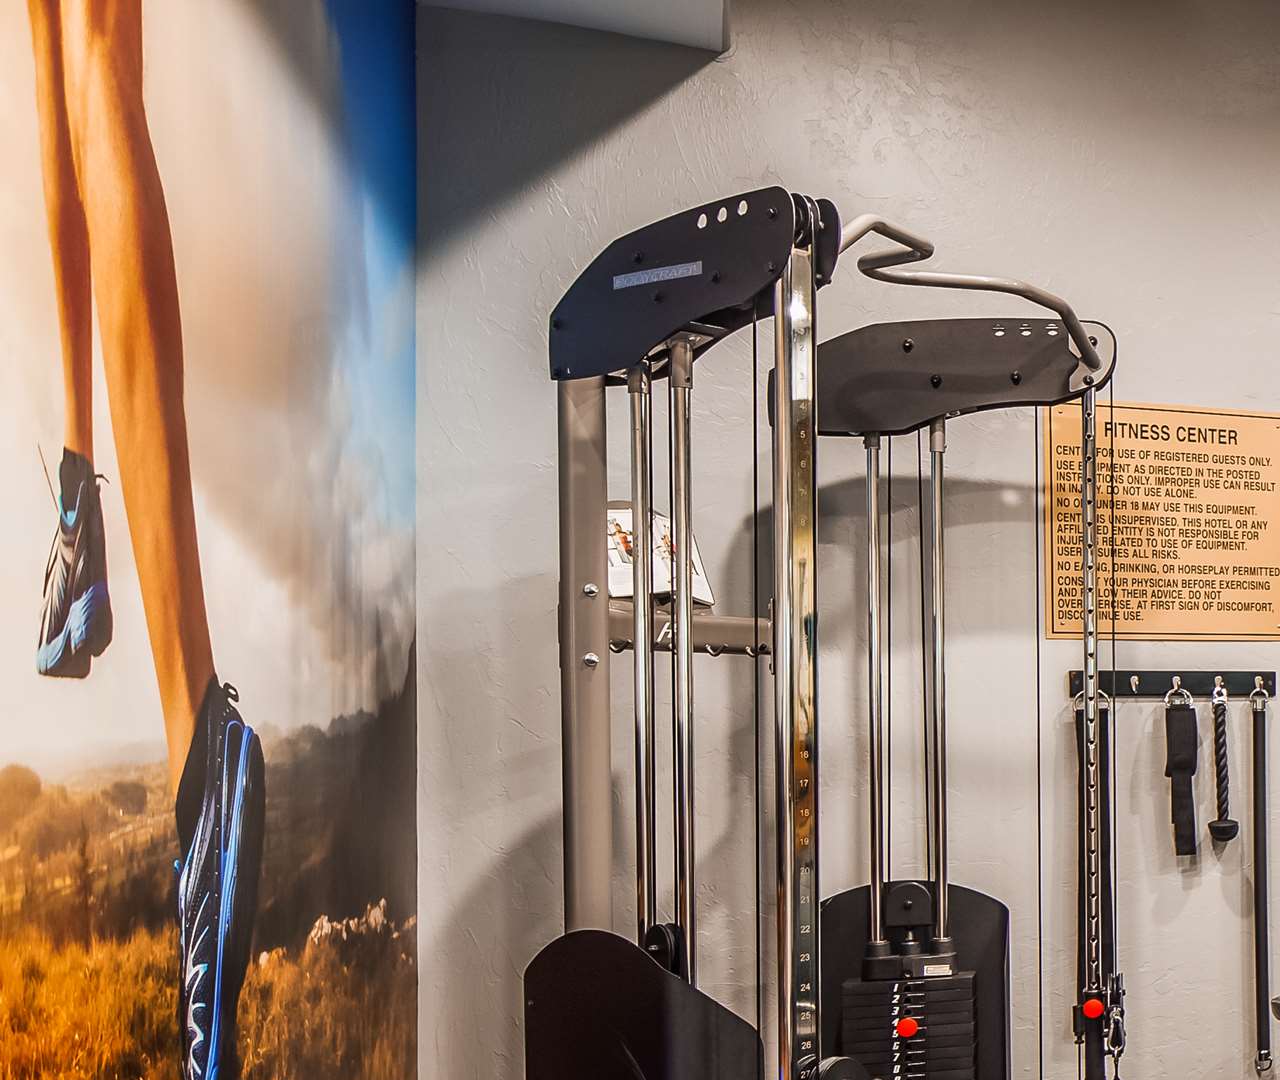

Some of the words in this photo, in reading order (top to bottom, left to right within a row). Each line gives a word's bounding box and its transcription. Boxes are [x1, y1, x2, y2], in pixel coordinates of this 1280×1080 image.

[1104, 421, 1170, 441] FITNESS
[1176, 425, 1238, 445] CENTER
[1056, 445, 1084, 456] CENT
[1096, 448, 1114, 458] FOR
[1118, 449, 1135, 459] USE
[1139, 450, 1151, 459] OF
[1154, 451, 1209, 463] REGISTERED
[1212, 455, 1247, 465] GUESTS
[1249, 457, 1272, 466] ONLY.
[1056, 461, 1075, 471] USE
[1078, 461, 1130, 473] EIPMENT
[1134, 465, 1145, 474] AS
[1149, 465, 1192, 477] DIRECTED
[1195, 468, 1204, 477] IN
[1207, 469, 1223, 478] THE
[1226, 470, 1260, 480] POSTED
[1056, 472, 1124, 484] INSTRTIONS
[1127, 475, 1152, 485] ONLY.
[1155, 477, 1200, 488] IMPROPER
[1203, 479, 1220, 489] USE
[1223, 480, 1240, 490] CAN
[1244, 481, 1276, 491] RESULT
[1056, 483, 1066, 492] IN
[1069, 484, 1104, 494] INJY.
[1106, 486, 1119, 494] DO
[1123, 486, 1141, 495] NOT
[1144, 487, 1161, 497] USE
[1165, 488, 1197, 498] ALONE.
[1056, 498, 1070, 507] NO
[1131, 501, 1140, 510] 18
[1142, 502, 1160, 511] MAY
[1163, 502, 1181, 512] USE
[1184, 503, 1203, 513] THIS
[1206, 504, 1257, 516] EQUIPMENT.
[1057, 513, 1084, 522] CENT
[1096, 514, 1105, 523] IS
[1109, 515, 1179, 527] UNSUPERVISED.
[1182, 517, 1201, 527] THIS
[1204, 518, 1233, 529] HOTEL
[1235, 520, 1248, 529] OR
[1250, 521, 1268, 531] ANY
[1057, 524, 1108, 535] AFFILED
[1112, 526, 1143, 536] ENTITY
[1146, 528, 1155, 536] IS
[1157, 528, 1176, 537] NOT
[1179, 529, 1239, 540] RESPONSIBLE
[1242, 531, 1259, 540] FOR
[1102, 537, 1143, 547] RELATED
[1146, 539, 1157, 548] TO
[1161, 539, 1178, 548] USE
[1181, 540, 1193, 549] OF
[1196, 540, 1247, 551] EQUIPMENT.
[1057, 547, 1082, 556] USER
[1094, 548, 1129, 558] SUMES
[1132, 549, 1149, 558] ALL
[1152, 549, 1180, 560] RISKS.
[1057, 561, 1071, 570] NO
[1074, 562, 1110, 573] EANG,
[1113, 563, 1159, 574] DRINKING,
[1162, 564, 1175, 573] OR
[1178, 565, 1230, 575] HORSEPLAY
[1104, 577, 1128, 587] YOUR
[1132, 578, 1178, 588] PHYSICIAN
[1181, 579, 1216, 589] BEFORE
[1219, 580, 1271, 591] EXERCISING
[1058, 588, 1077, 597] AND
[1122, 589, 1147, 598] THEIR
[1151, 590, 1185, 599] ADVICE.
[1188, 590, 1201, 599] DO
[1204, 591, 1222, 600] NOT
[1137, 600, 1148, 609] AT
[1151, 601, 1175, 610] FIRST
[1179, 601, 1199, 610] SIGN
[1202, 601, 1214, 611] OF
[1217, 601, 1274, 613] DISCOMFORT,
[1058, 610, 1120, 620] DISCOINUE
[1123, 611, 1144, 621] USE.
[799, 779, 809, 787] 17
[800, 925, 811, 934] 22
[800, 953, 811, 962] 23
[800, 983, 811, 992] 24
[801, 1012, 811, 1020] 25
[801, 1041, 812, 1049] 26
[800, 1070, 811, 1079] 27
